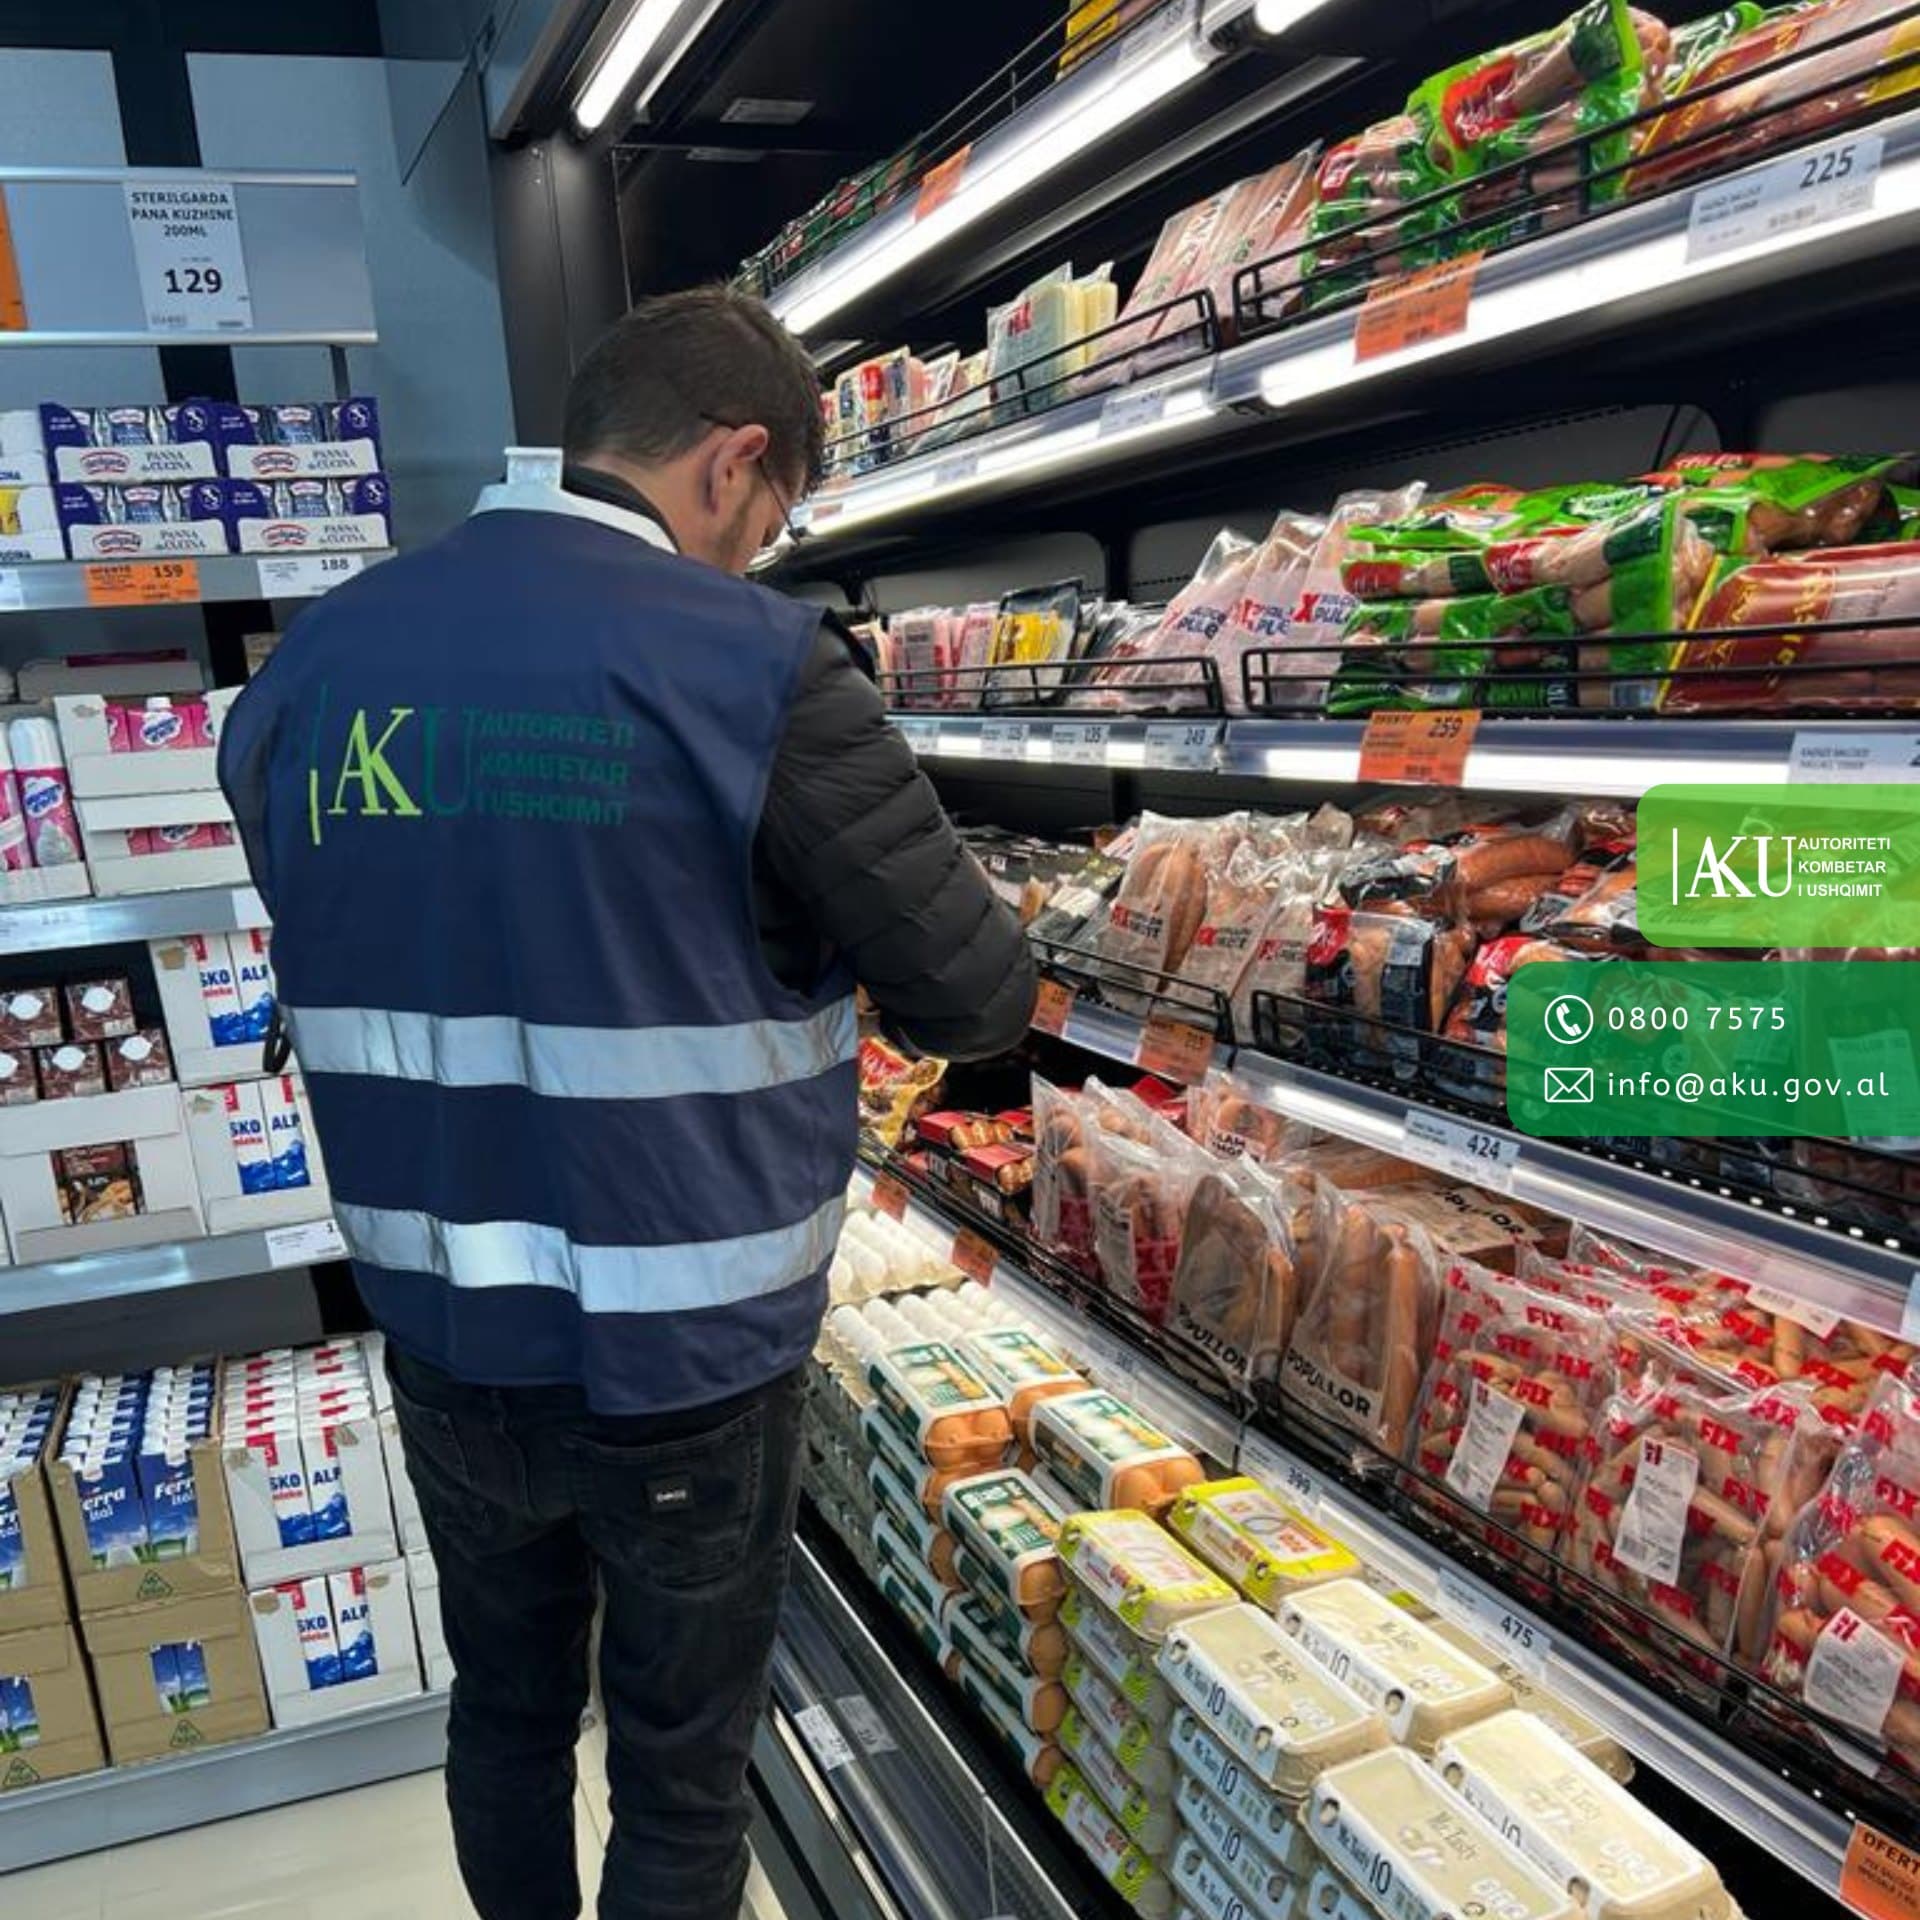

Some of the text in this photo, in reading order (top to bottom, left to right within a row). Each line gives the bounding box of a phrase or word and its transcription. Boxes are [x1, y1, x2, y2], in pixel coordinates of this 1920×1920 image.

[1799, 145, 1857, 188] 225
[131, 191, 228, 204] STERILGARDA
[132, 208, 233, 220] PANA KUZHINE
[164, 224, 207, 237] 200ML
[164, 267, 222, 294] 129
[153, 564, 184, 578] 159
[321, 558, 349, 571] 188
[1428, 716, 1463, 739] 259
[327, 706, 475, 818] AKU
[1467, 1134, 1501, 1160] 424
[1526, 1306, 1564, 1332] FIX
[1701, 1418, 1743, 1454] FIX
[1501, 1615, 1534, 1648] 475
[1208, 1680, 1226, 1716] 10
[1218, 1760, 1239, 1796] 10
[1222, 1827, 1241, 1861] 10
[1369, 1852, 1393, 1895] 10
